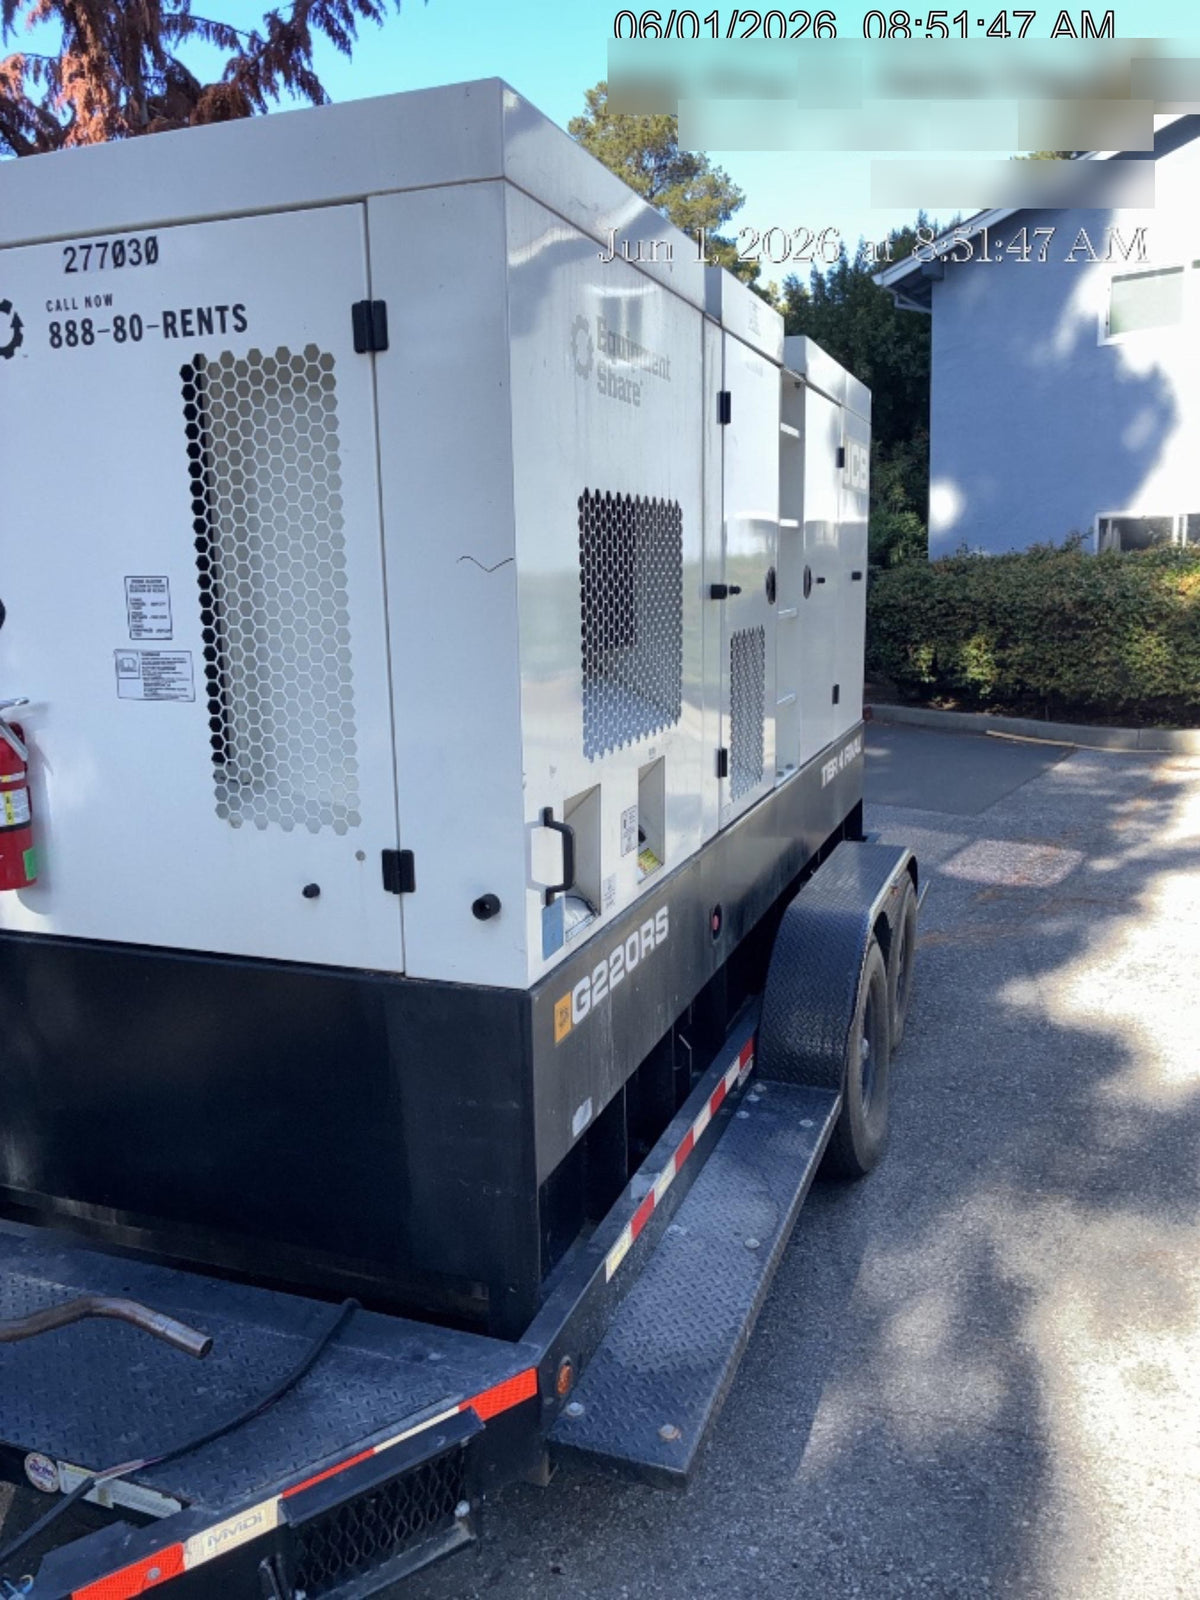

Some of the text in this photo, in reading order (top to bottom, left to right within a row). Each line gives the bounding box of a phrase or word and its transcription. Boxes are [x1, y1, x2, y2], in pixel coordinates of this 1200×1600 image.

[62, 235, 160, 273] 277030
[45, 293, 113, 313] CALL NOW
[48, 303, 248, 350] 888-80-RENTS
[572, 905, 669, 1025] G220RS
